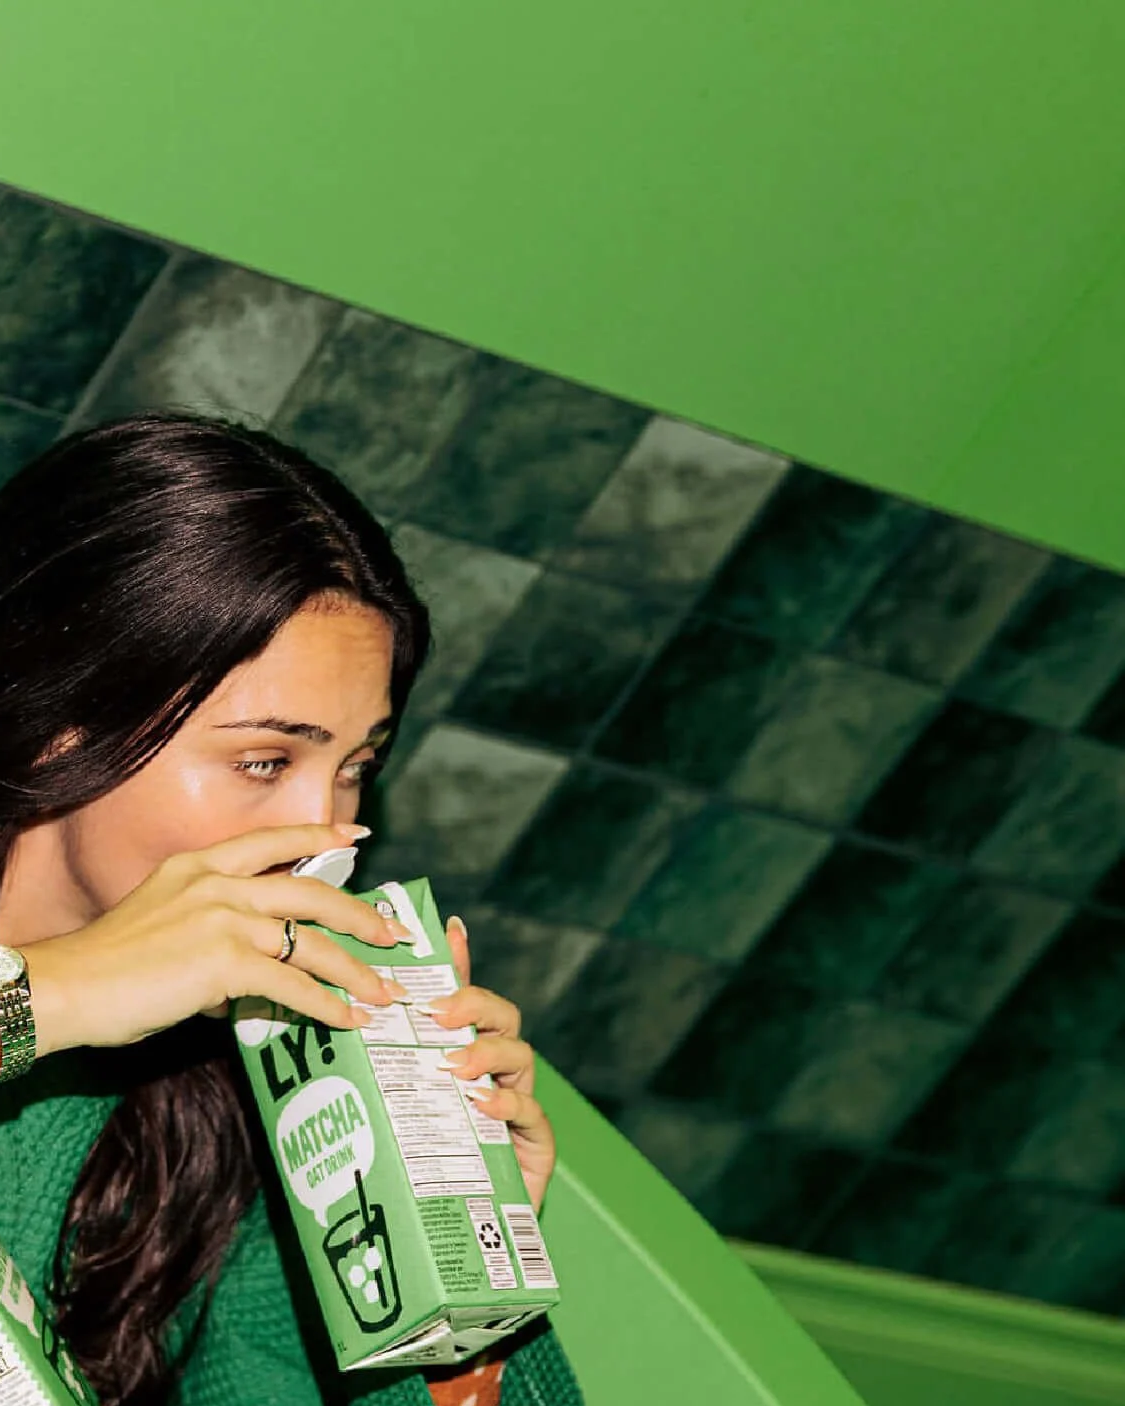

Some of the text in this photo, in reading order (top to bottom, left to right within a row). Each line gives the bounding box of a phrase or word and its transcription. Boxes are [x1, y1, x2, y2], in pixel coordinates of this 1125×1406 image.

[259, 1022, 335, 1103] LY!
[281, 1091, 365, 1174] MATCHA
[306, 1143, 355, 1189] OAT DRINK
